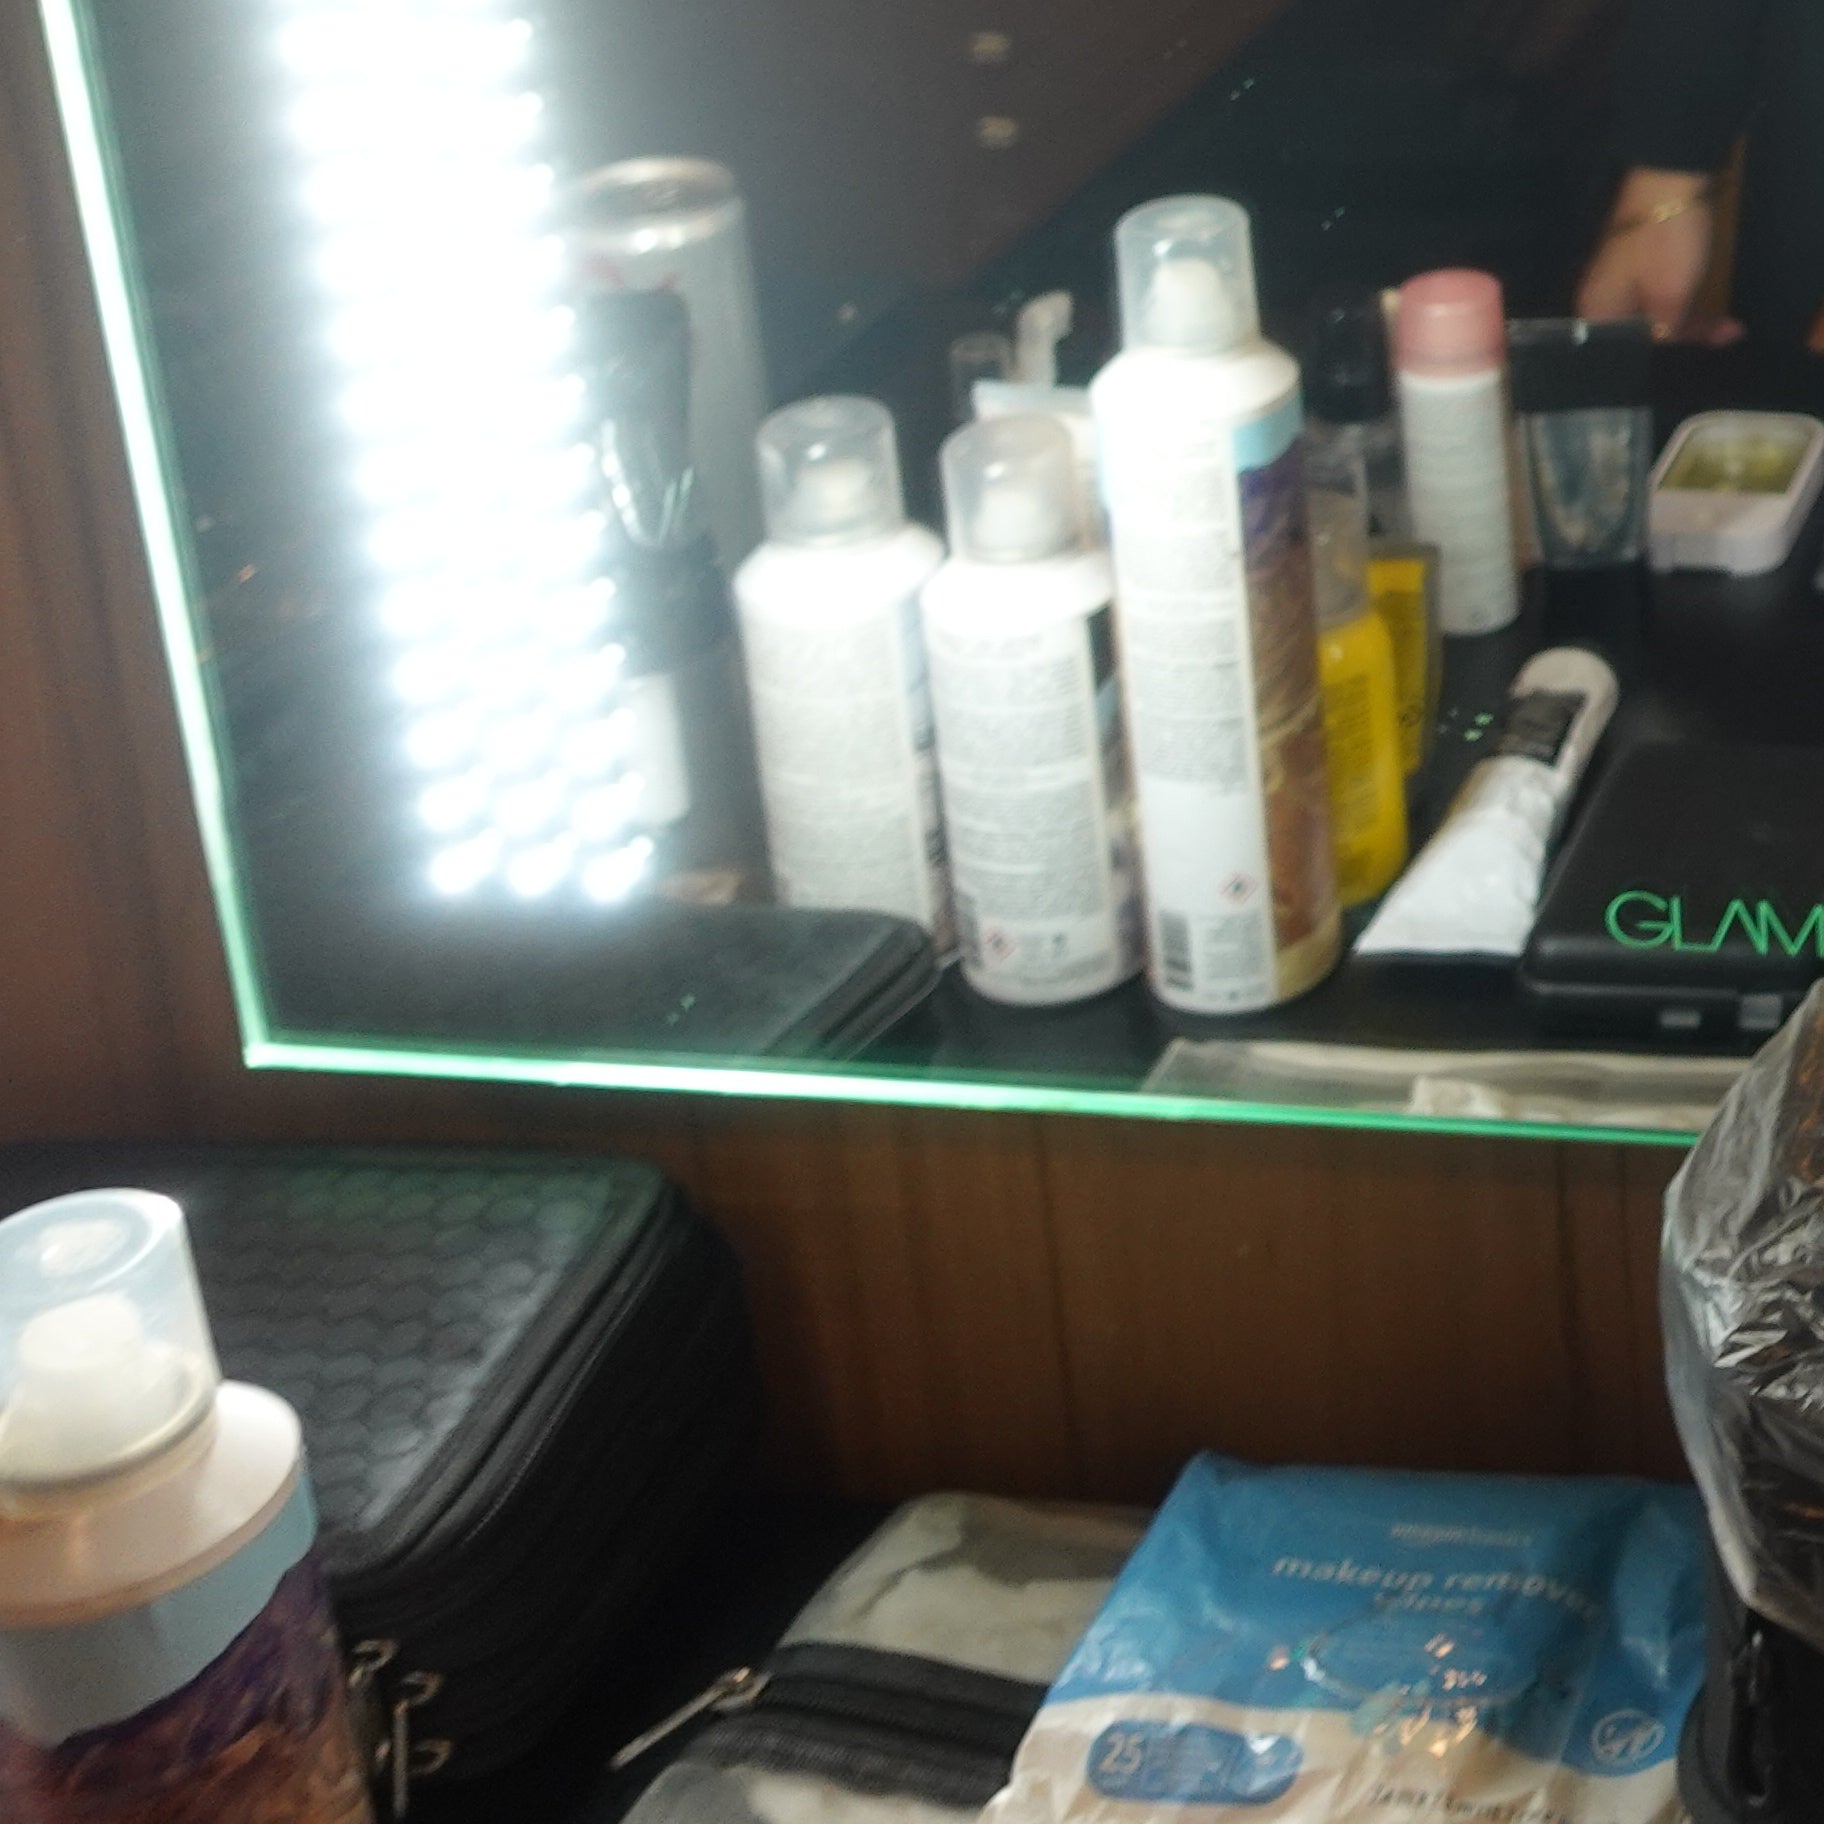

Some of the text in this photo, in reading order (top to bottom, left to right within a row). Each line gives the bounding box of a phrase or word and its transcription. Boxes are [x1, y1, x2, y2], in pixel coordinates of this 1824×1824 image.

[1272, 1555, 1602, 1618] makeup remover
[1100, 1732, 1145, 1774] 25
